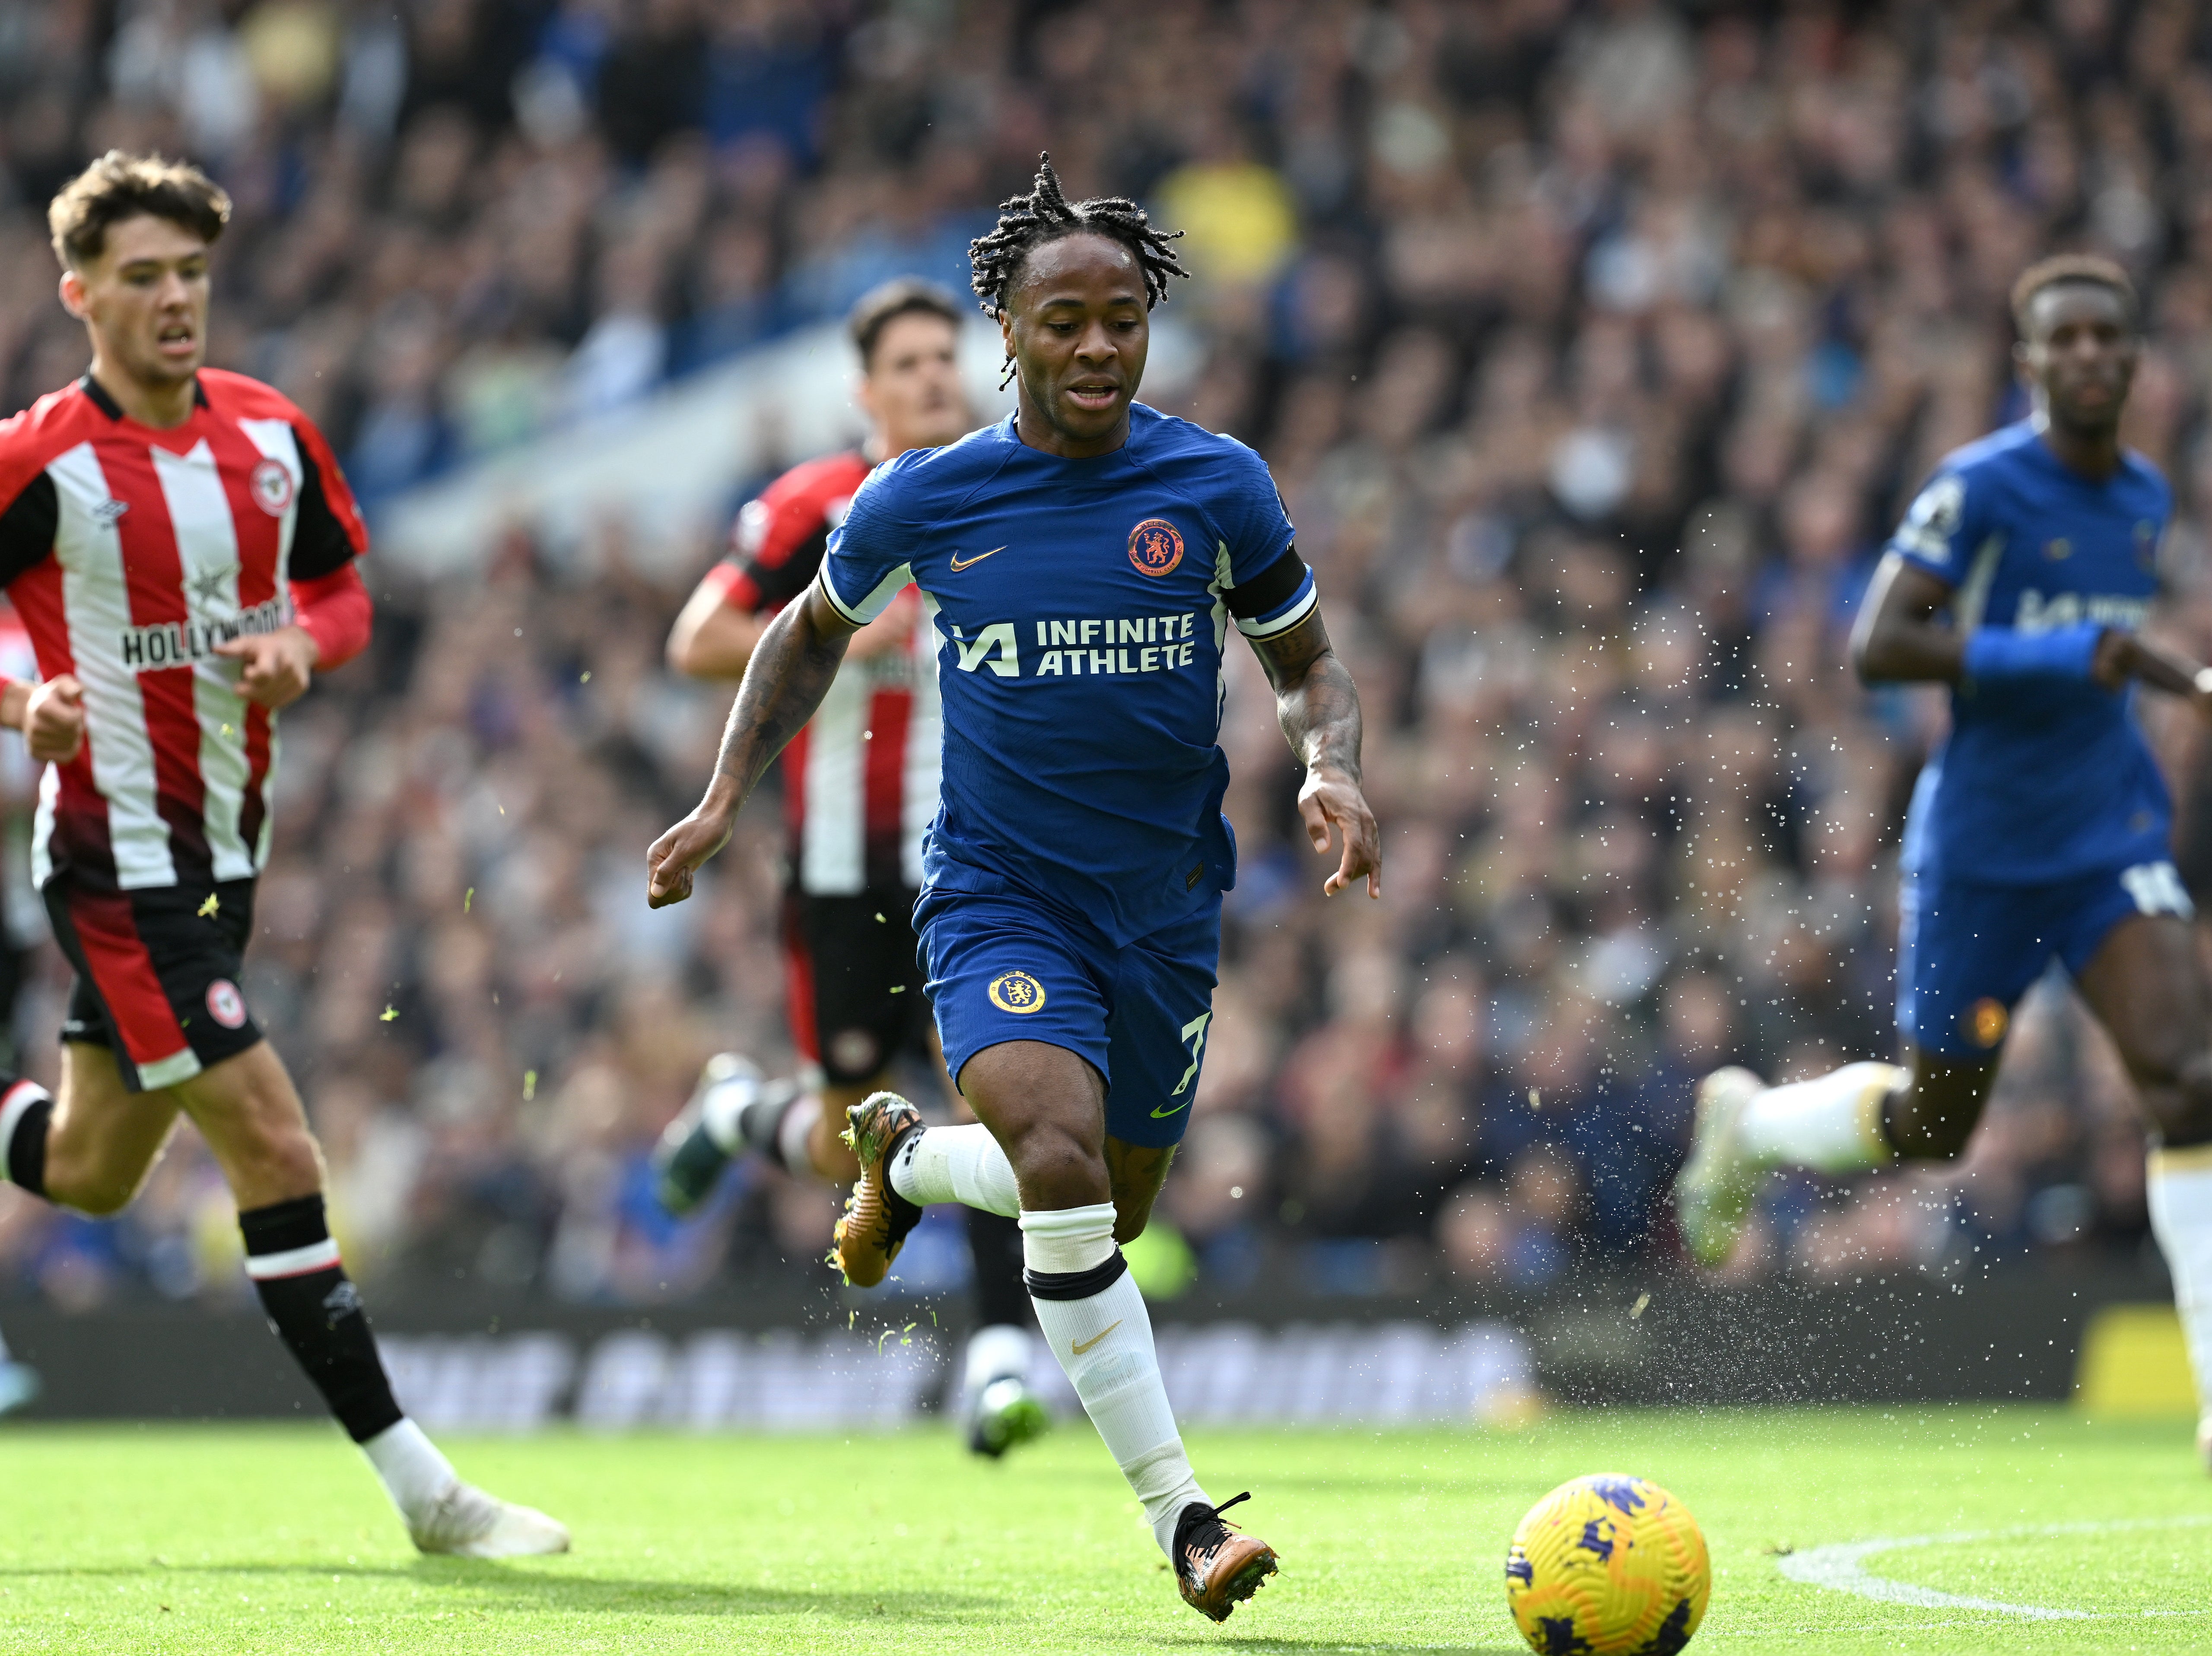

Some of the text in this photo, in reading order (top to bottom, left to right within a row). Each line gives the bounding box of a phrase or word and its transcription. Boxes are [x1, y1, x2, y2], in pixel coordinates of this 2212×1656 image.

[1138, 562, 1176, 574] FOOTBALL CLUB
[1036, 612, 1195, 646] INFINITE
[1036, 640, 1195, 676] ATHLETE
[1171, 1011, 1211, 1096] 7
